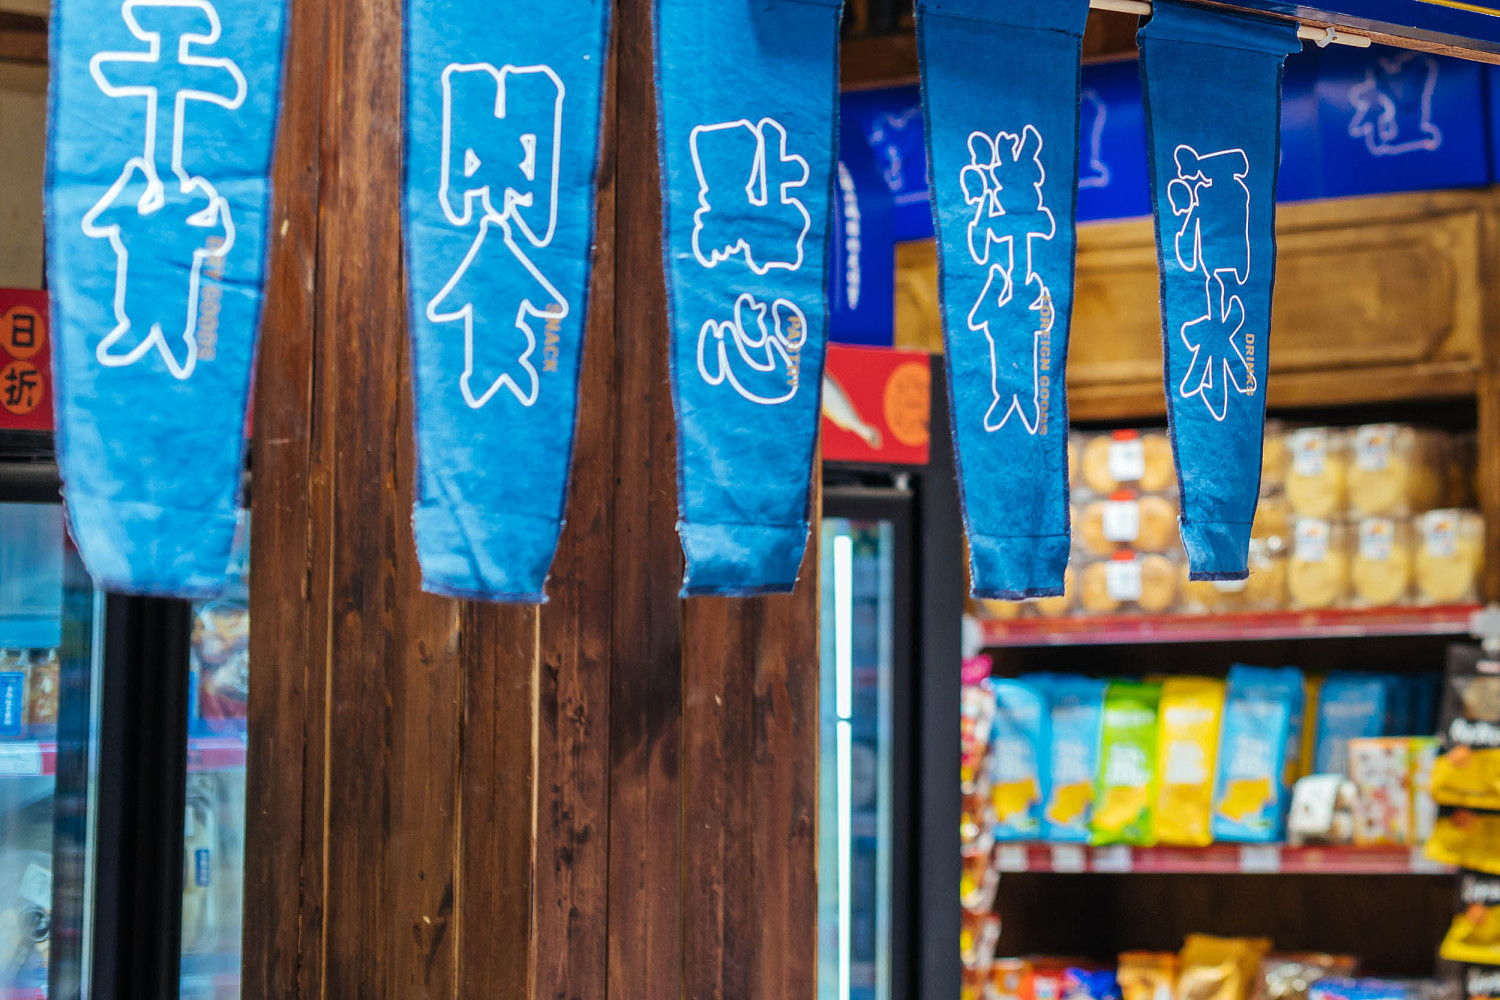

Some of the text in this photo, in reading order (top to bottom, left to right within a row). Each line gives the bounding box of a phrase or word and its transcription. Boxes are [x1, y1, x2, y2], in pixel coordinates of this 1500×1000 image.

[1167, 144, 1257, 422] 酒水
[196, 285, 223, 362] GOODS
[543, 303, 561, 373] SNACK
[1037, 295, 1052, 436] FOREIGN GOODS
[1244, 333, 1256, 397] DRINKS
